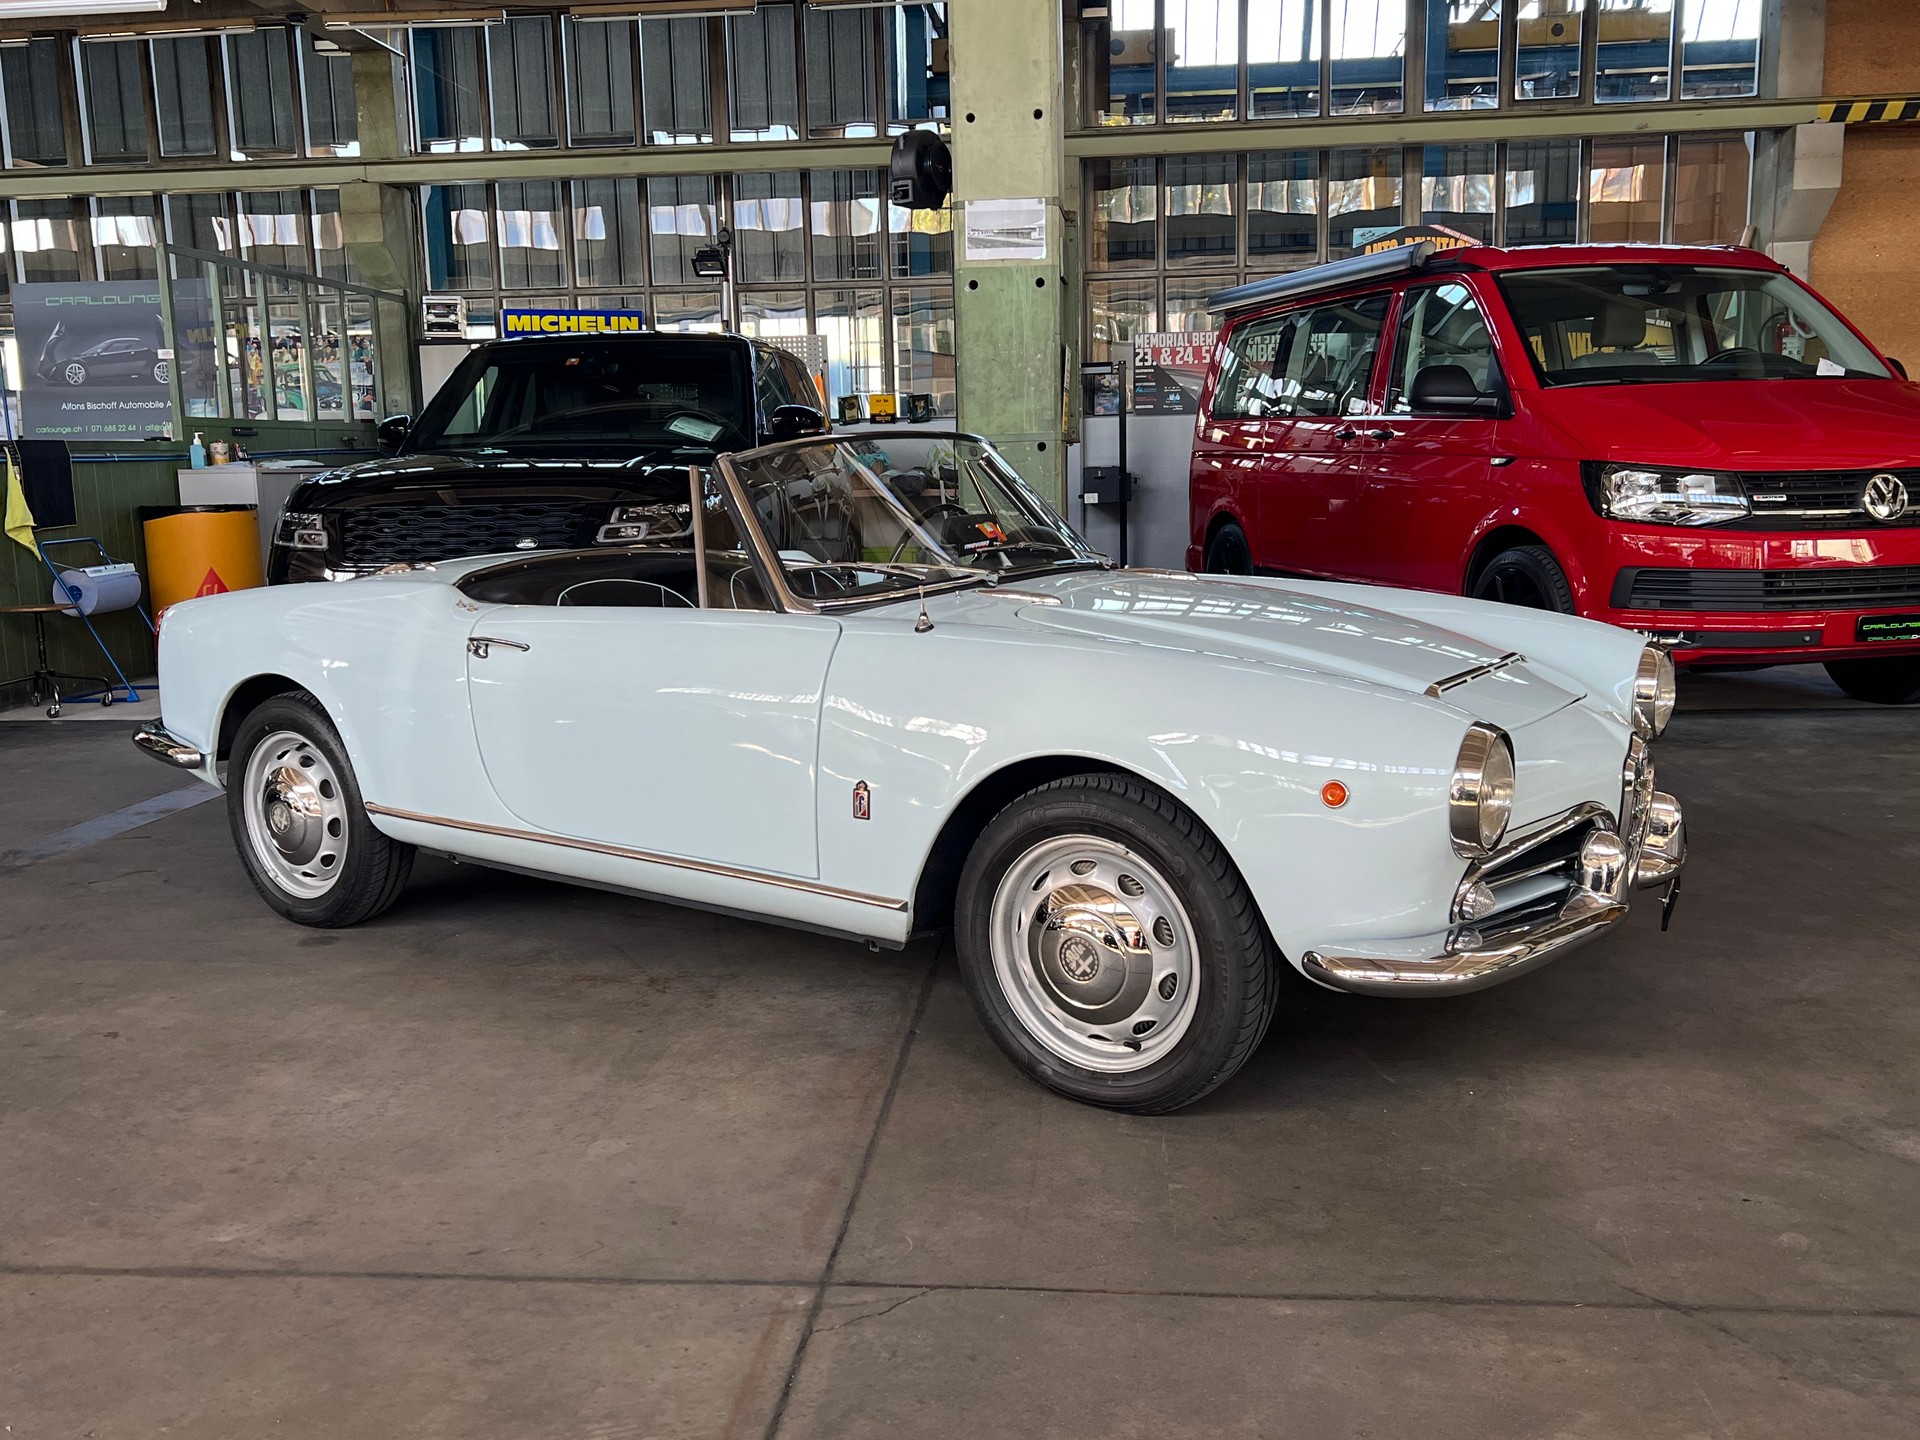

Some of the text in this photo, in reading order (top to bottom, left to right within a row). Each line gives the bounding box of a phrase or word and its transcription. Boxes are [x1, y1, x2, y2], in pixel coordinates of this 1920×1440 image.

[45, 294, 162, 306] CARLOUNG
[506, 314, 639, 331] MICHELIN
[1135, 332, 1190, 348] MEMORIAL
[1134, 348, 1157, 366] 23.
[1160, 347, 1172, 365] &
[1175, 346, 1199, 365] 24.
[61, 402, 85, 411] Alfons
[86, 401, 117, 410] Bischoff
[118, 400, 165, 409] Automobile
[35, 424, 82, 433] carlounge.ch
[1863, 621, 1920, 631] CARLOUNG
